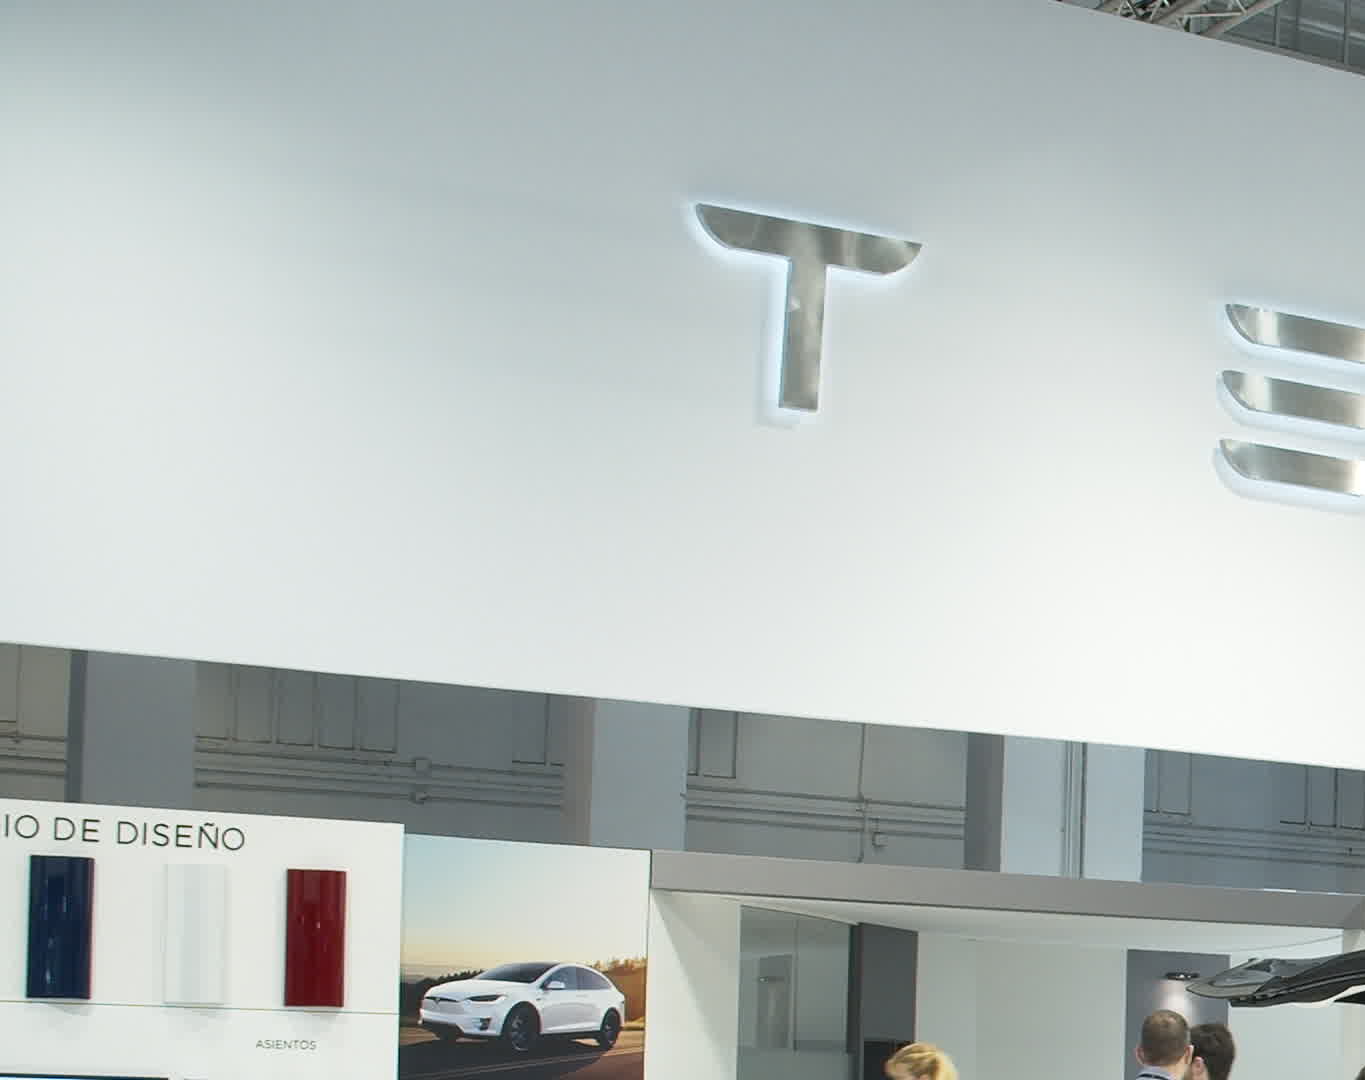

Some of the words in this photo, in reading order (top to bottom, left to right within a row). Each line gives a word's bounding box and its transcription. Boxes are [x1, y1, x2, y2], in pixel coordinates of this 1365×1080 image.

[4, 813, 40, 839] IO
[53, 816, 101, 843] DE
[116, 820, 246, 851] DISEÑO
[255, 1039, 318, 1051] ASIENTOS
